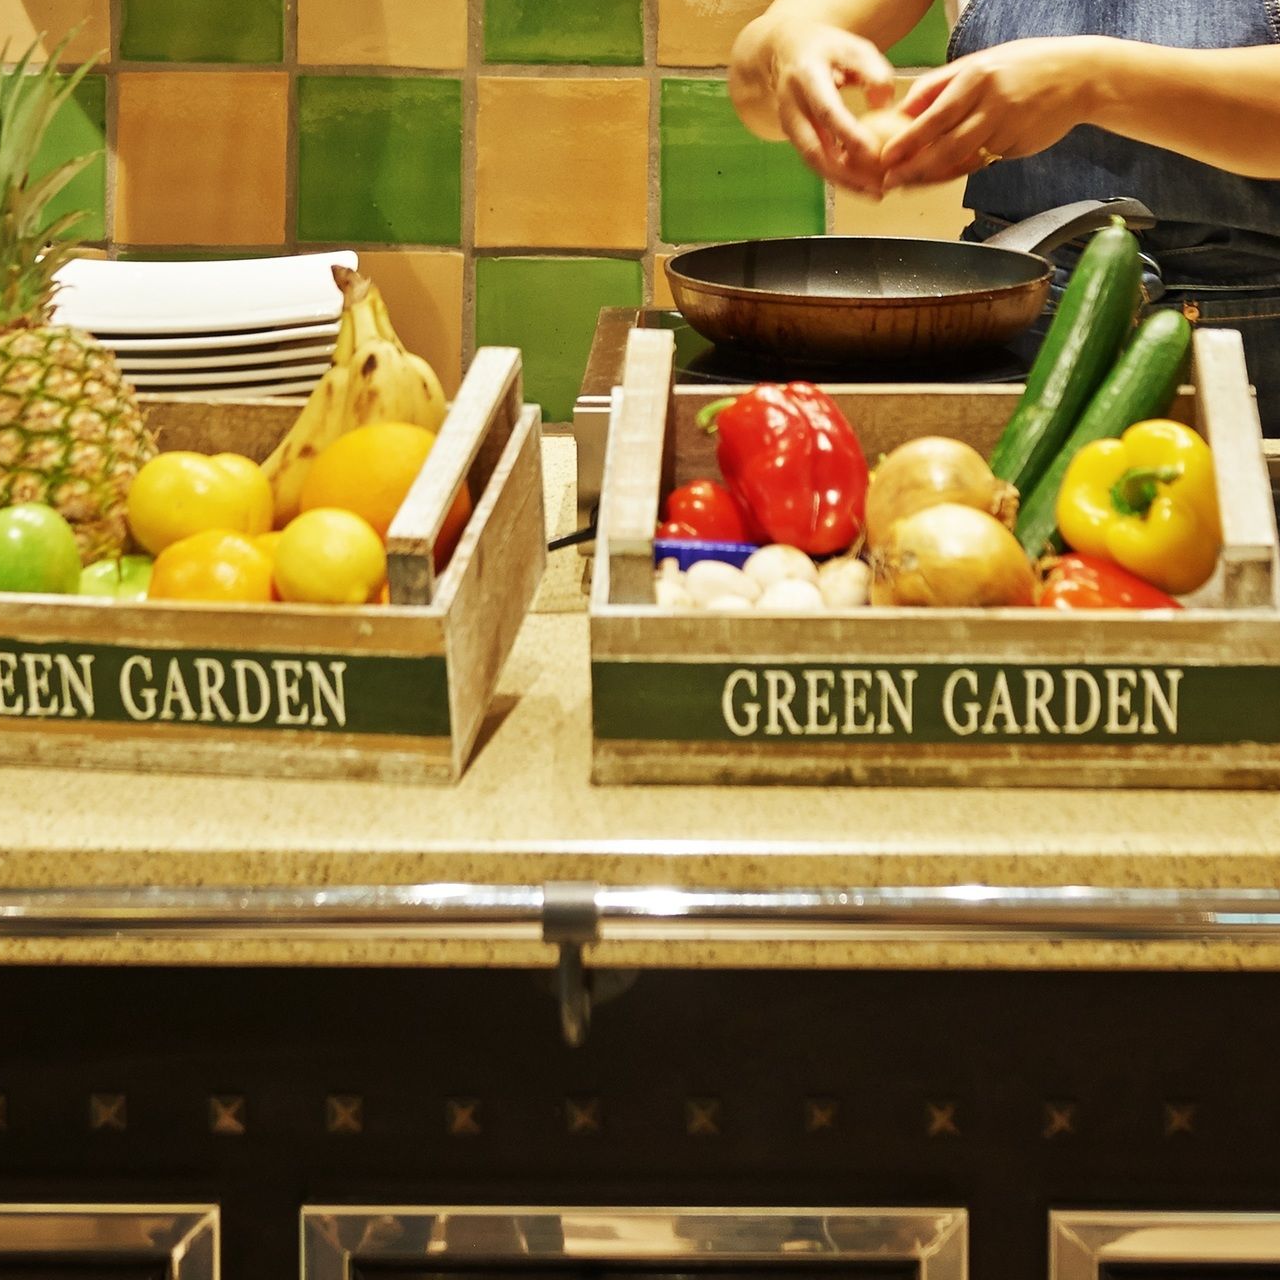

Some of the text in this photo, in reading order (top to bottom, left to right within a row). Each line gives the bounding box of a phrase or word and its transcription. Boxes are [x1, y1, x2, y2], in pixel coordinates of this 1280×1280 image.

[120, 655, 347, 727] GARDEN
[722, 668, 1184, 737] GREEN GARDEN
